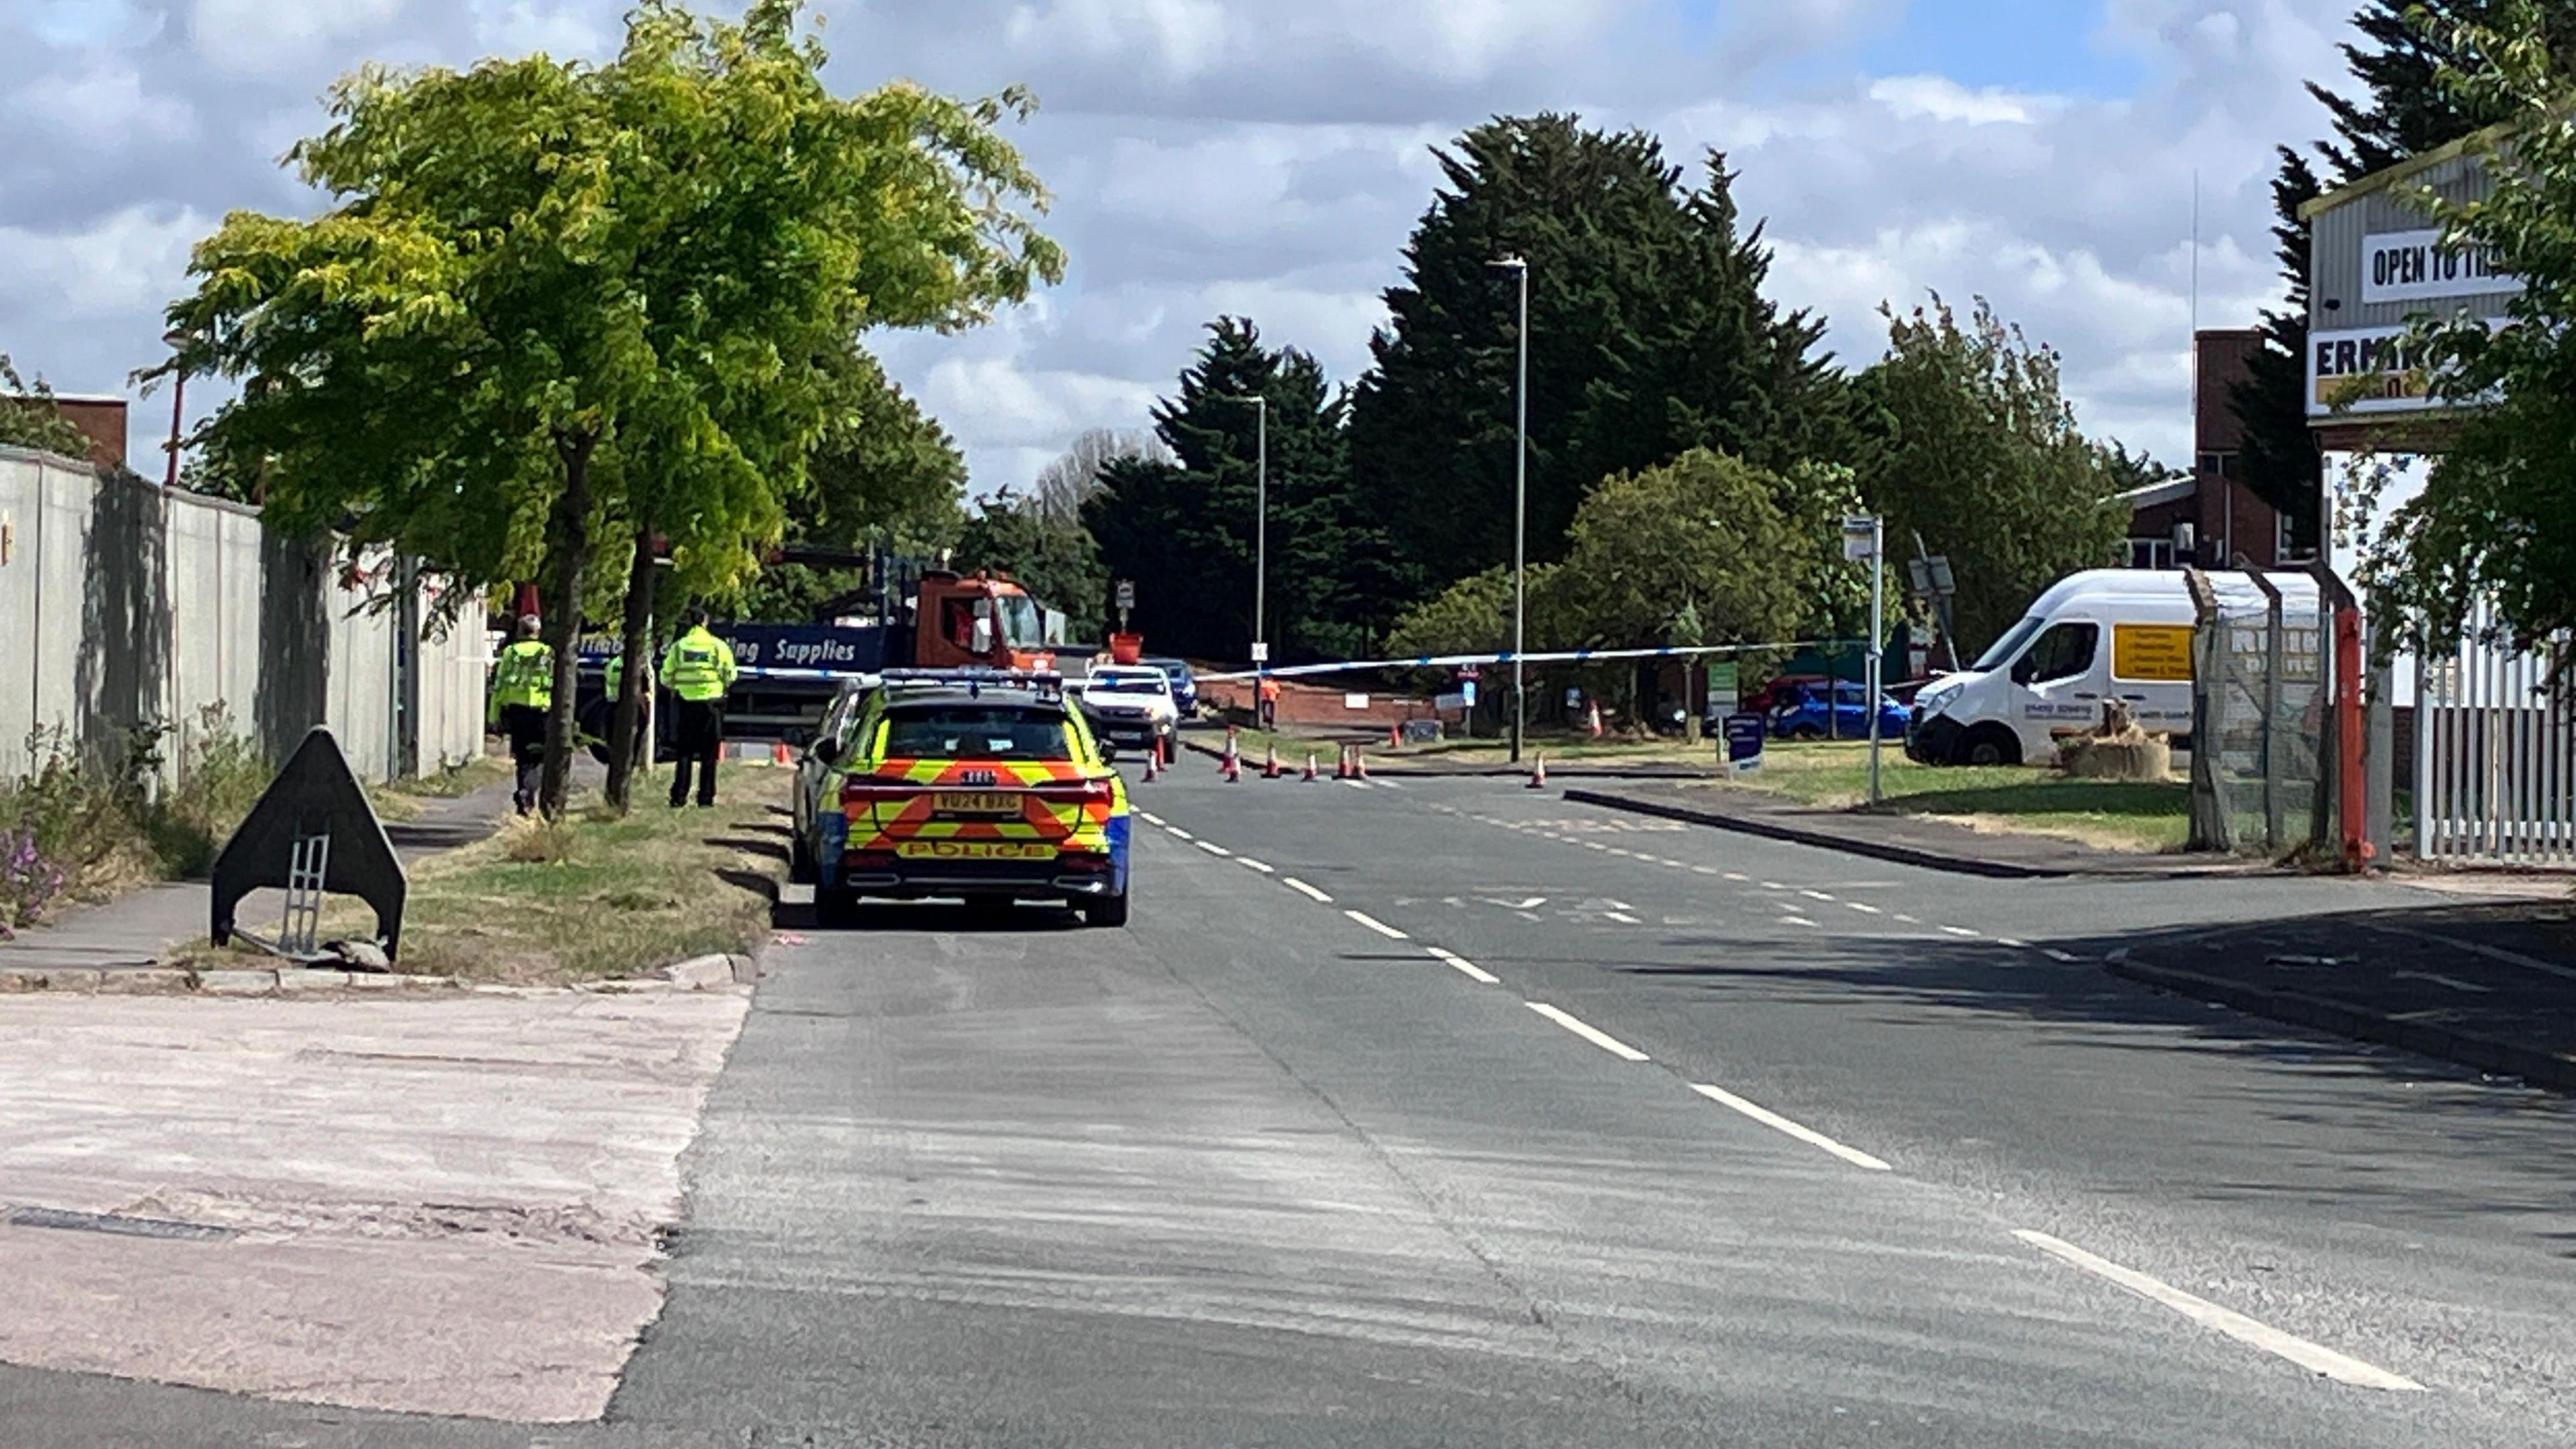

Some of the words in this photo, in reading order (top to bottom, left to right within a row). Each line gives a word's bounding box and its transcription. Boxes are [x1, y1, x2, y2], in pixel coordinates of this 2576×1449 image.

[2373, 246, 2425, 285] OPEN
[775, 638, 855, 664] Supplies
[908, 843, 1046, 857] POLICE
